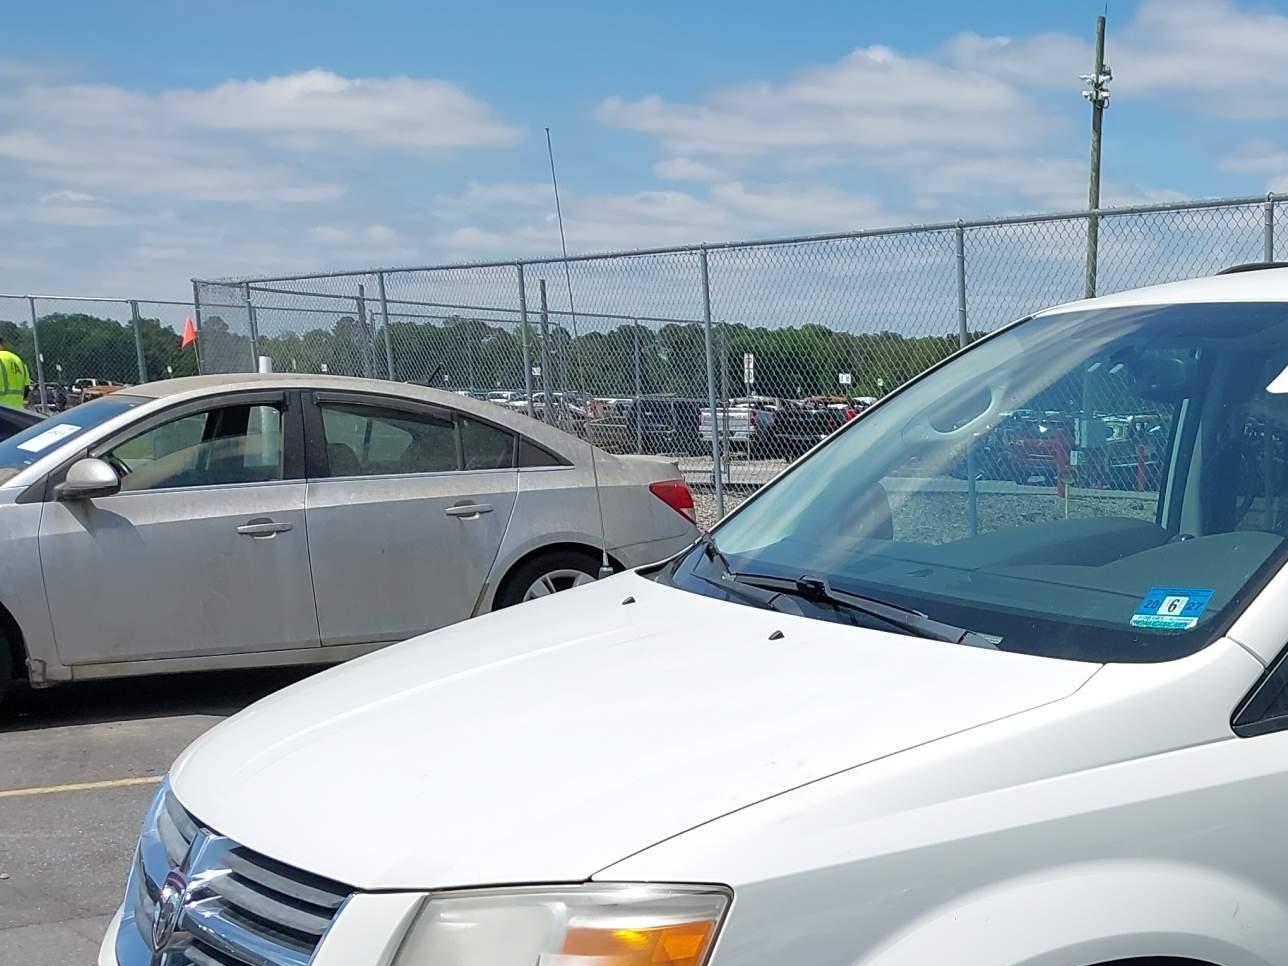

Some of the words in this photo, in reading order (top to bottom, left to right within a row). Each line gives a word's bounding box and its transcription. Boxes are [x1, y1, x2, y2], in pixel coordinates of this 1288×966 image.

[1144, 599, 1160, 610] 20
[1167, 598, 1180, 613] 6
[1185, 602, 1204, 611] 27
